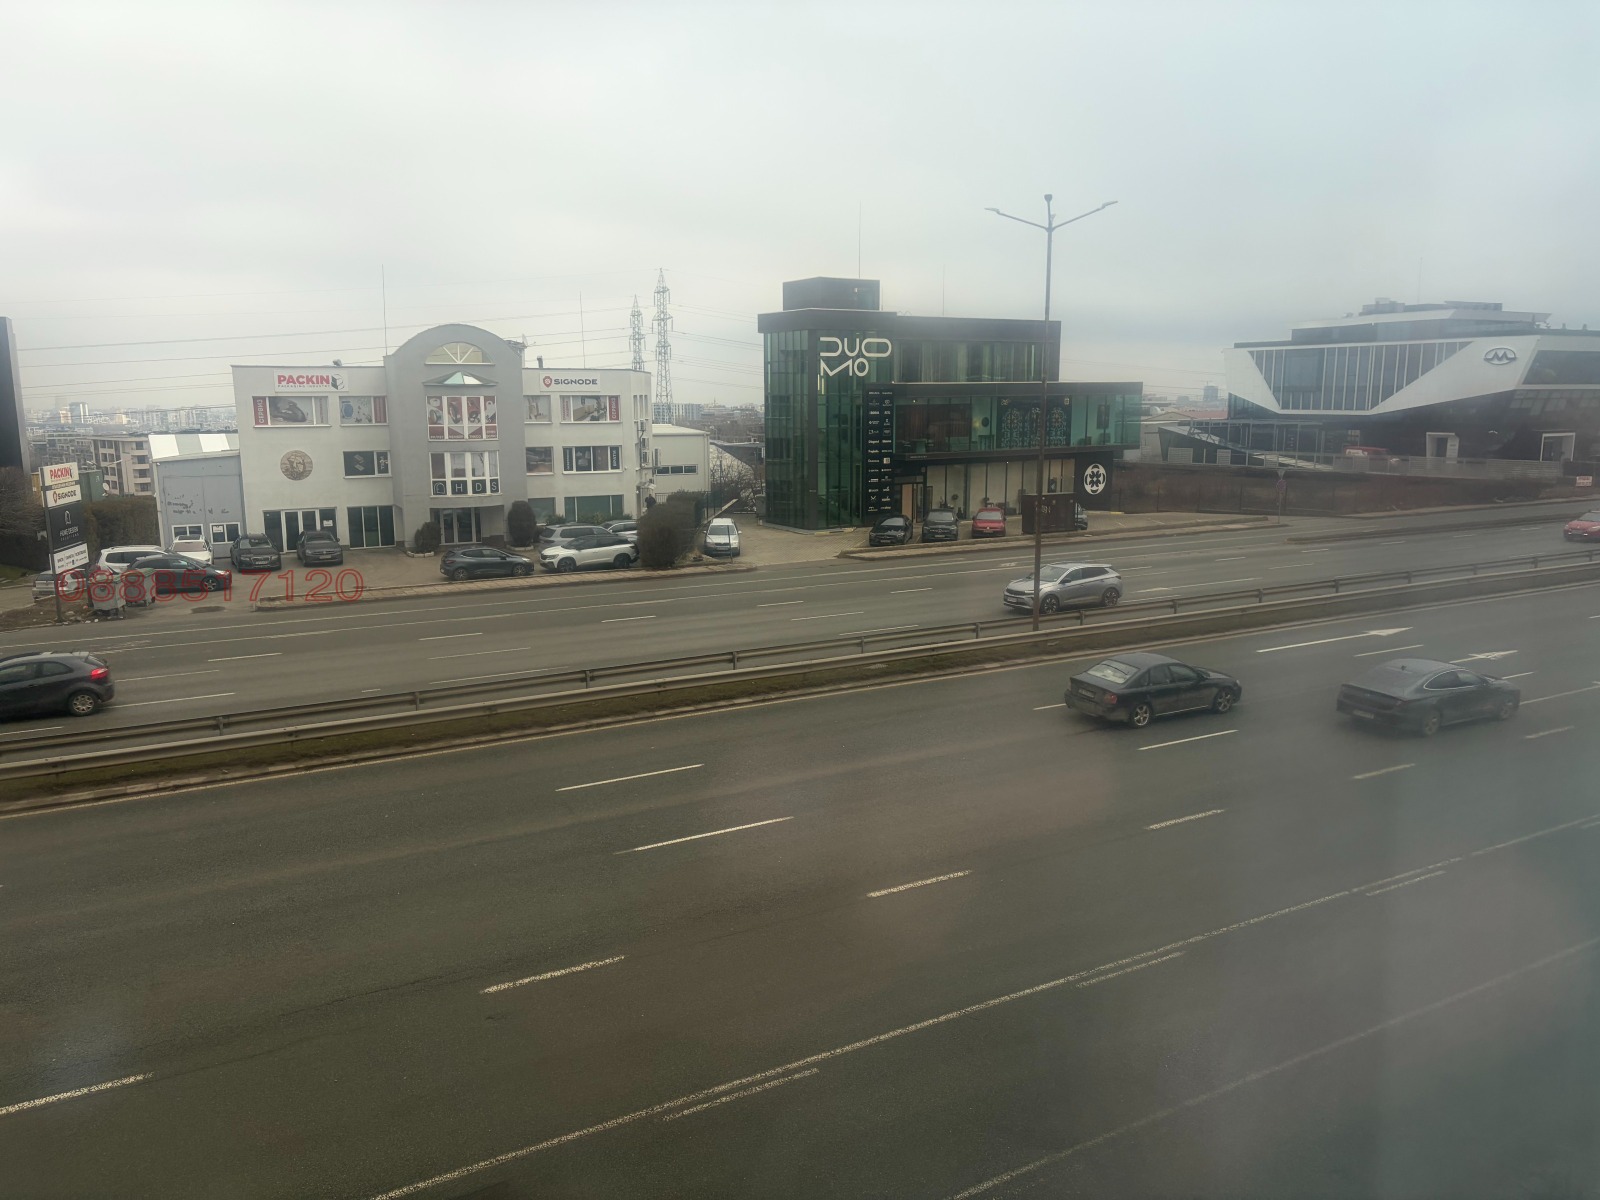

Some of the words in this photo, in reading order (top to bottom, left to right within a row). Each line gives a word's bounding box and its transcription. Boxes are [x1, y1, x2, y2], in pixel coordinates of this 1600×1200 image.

[819, 336, 892, 358] DUO
[820, 358, 869, 377] MO
[277, 374, 330, 385] PACKIN
[49, 466, 71, 480] PACKIN
[57, 489, 77, 500] SIGNODE
